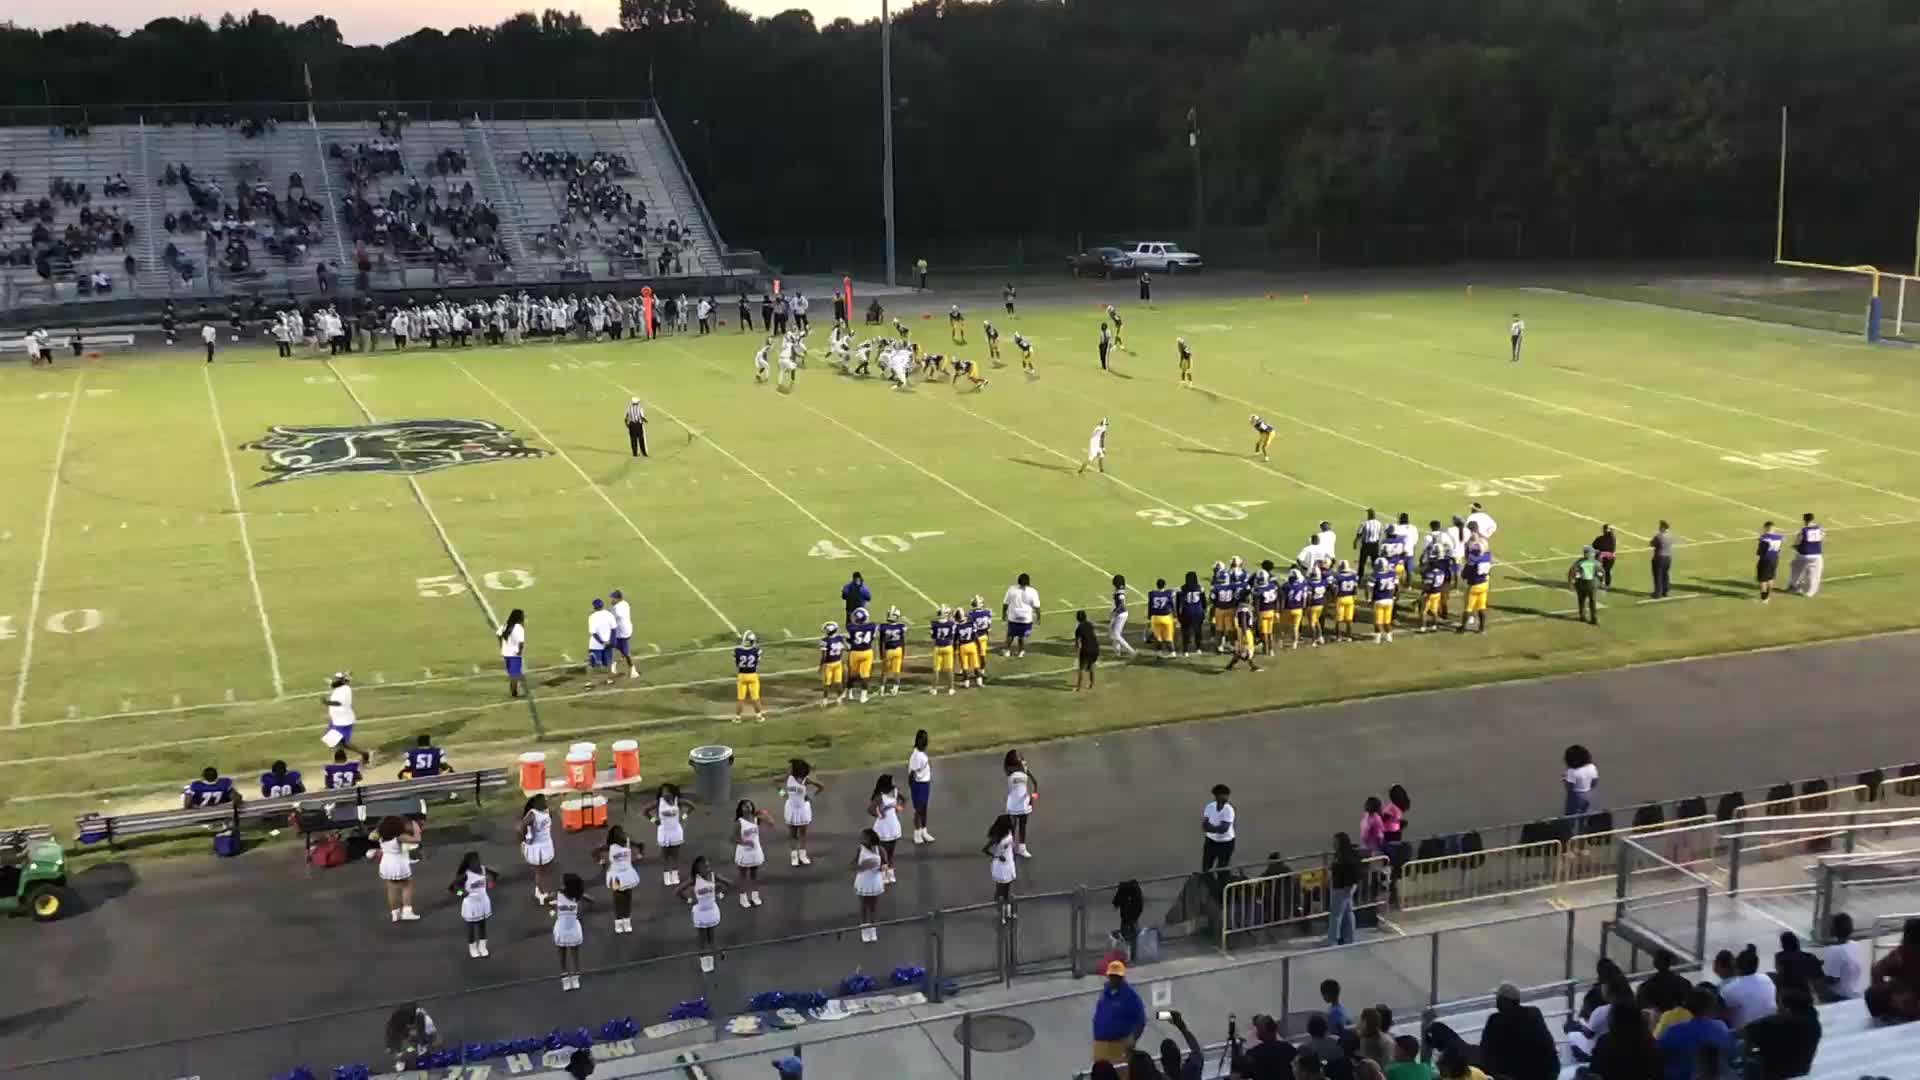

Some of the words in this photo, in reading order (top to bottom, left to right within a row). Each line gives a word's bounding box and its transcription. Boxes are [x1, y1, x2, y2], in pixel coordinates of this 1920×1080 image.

[1136, 503, 1248, 527] 30
[808, 534, 911, 559] 40
[416, 569, 535, 598] 50
[1153, 597, 1168, 609] 57
[854, 631, 872, 645] 54
[739, 655, 756, 669] 22
[416, 753, 433, 770] 51
[333, 771, 354, 789] 53
[201, 791, 222, 807] 77
